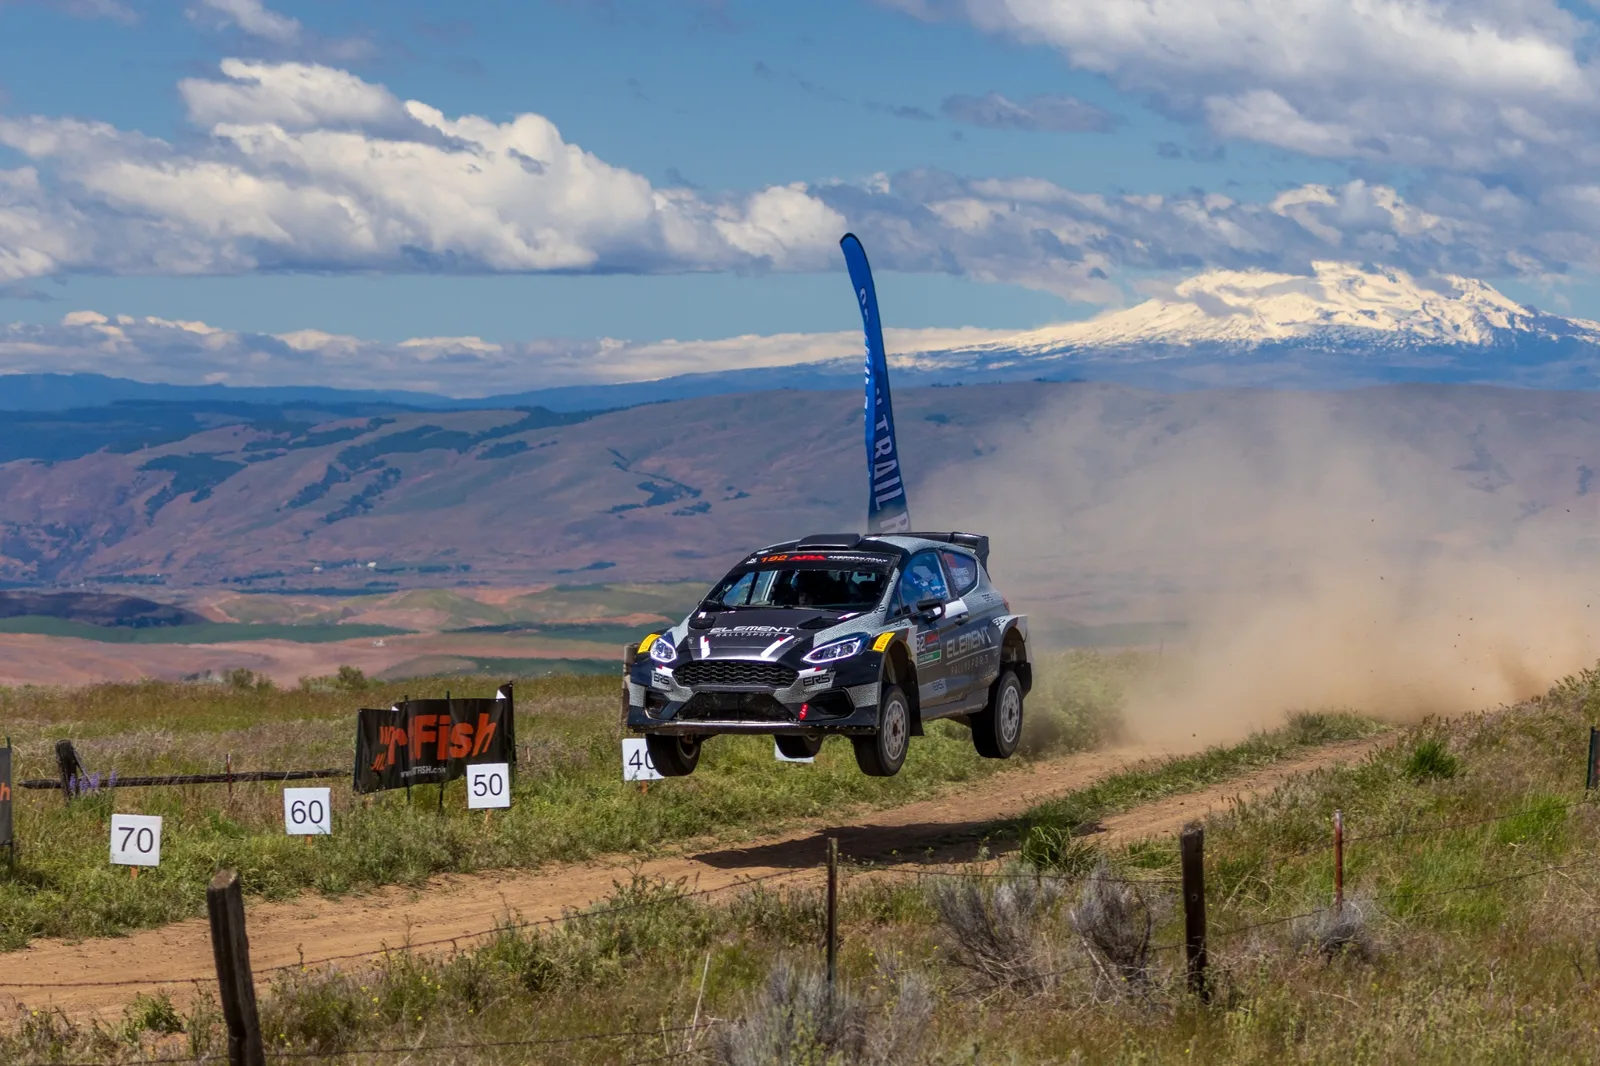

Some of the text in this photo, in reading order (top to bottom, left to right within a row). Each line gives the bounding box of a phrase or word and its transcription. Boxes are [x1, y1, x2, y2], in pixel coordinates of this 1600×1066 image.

[874, 414, 903, 511] TRAIL
[653, 672, 670, 685] ERS
[803, 673, 831, 687] ERS
[473, 773, 503, 797] 50
[291, 800, 324, 824] 60
[118, 826, 154, 853] 70
